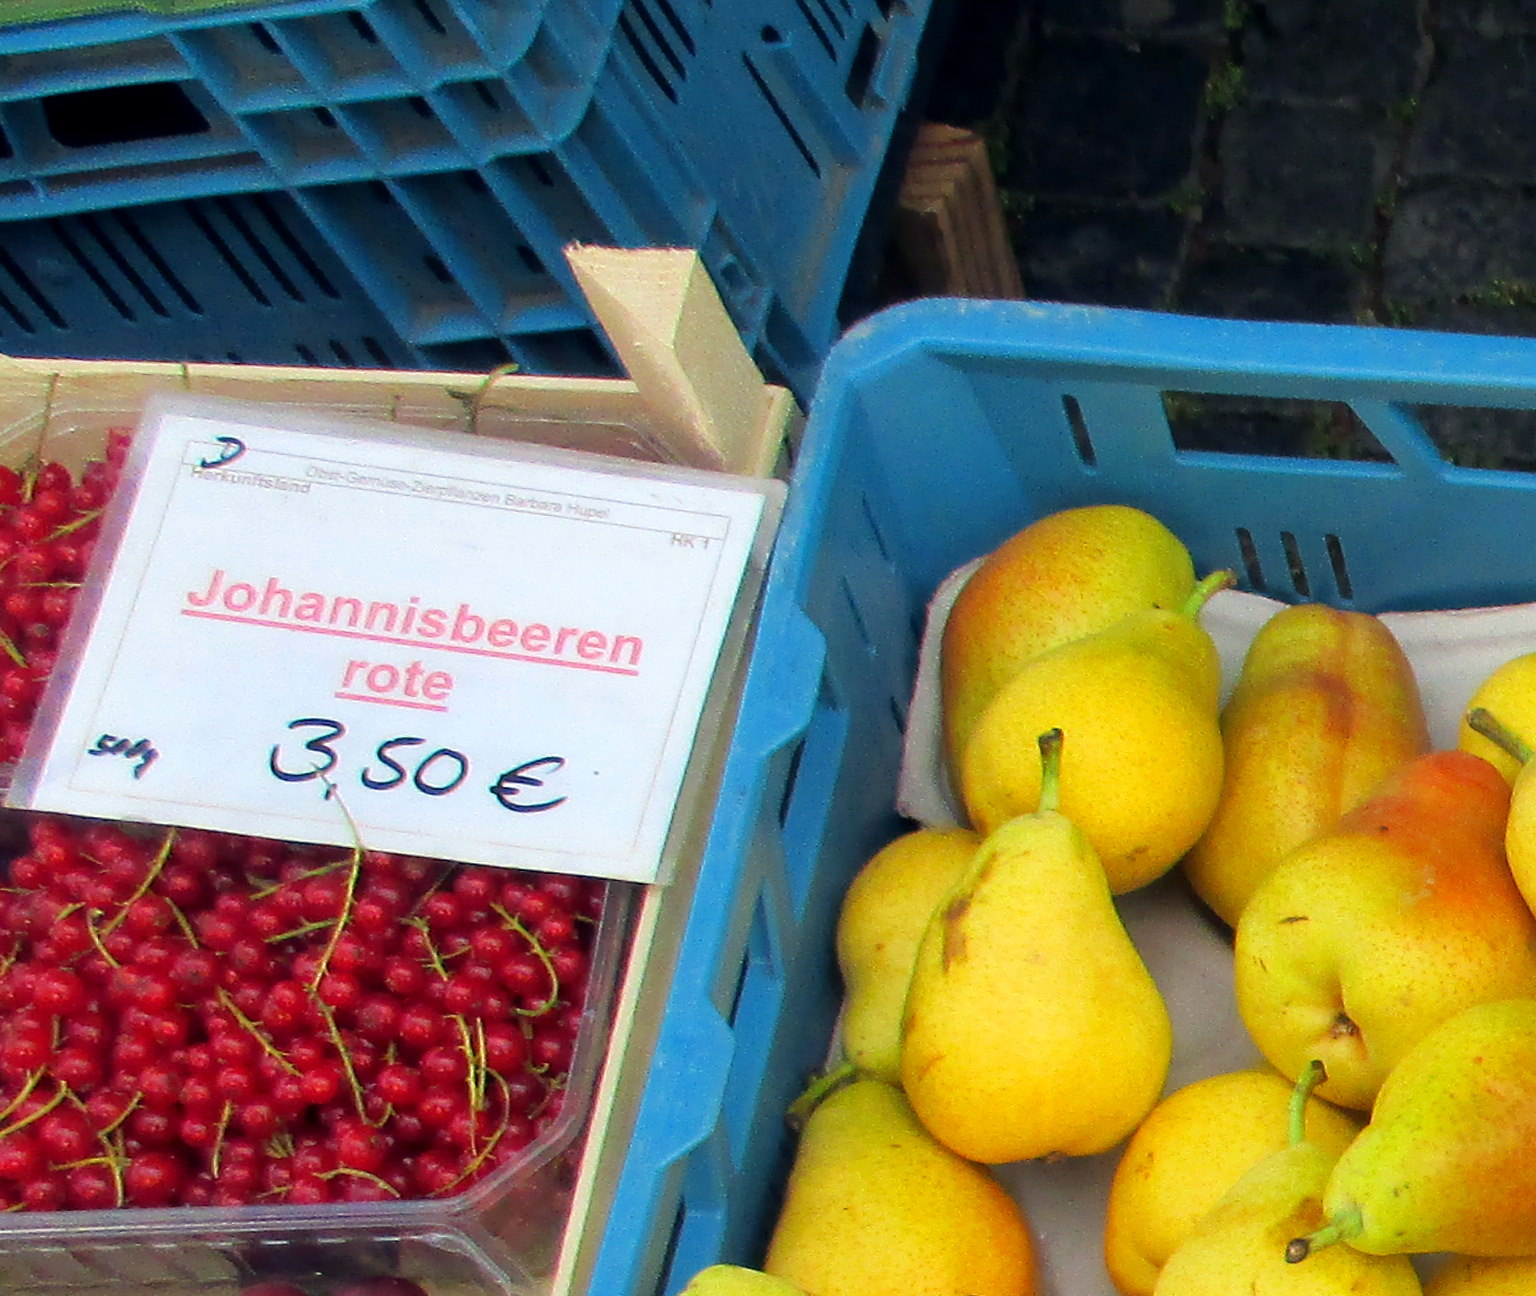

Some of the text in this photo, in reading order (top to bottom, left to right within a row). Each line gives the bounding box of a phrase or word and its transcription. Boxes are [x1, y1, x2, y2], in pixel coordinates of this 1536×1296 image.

[191, 464, 312, 494] Herkunftsland
[185, 568, 644, 668] Johannisbeeren
[340, 656, 455, 702] rote
